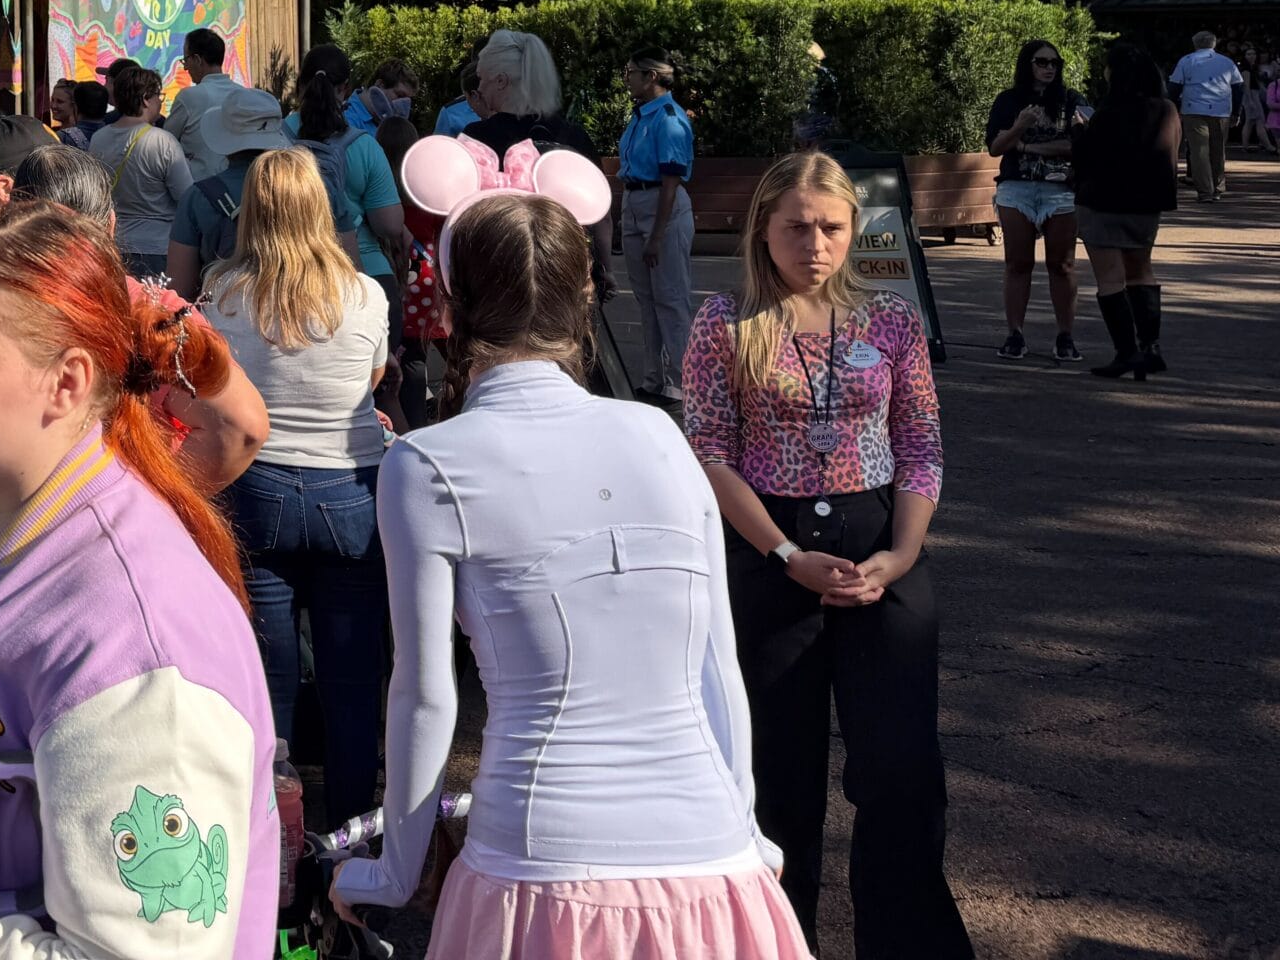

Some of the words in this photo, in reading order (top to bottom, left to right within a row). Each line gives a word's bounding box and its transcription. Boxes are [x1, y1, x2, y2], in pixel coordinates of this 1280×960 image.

[145, 28, 171, 49] DAY
[855, 233, 897, 249] VIEW
[857, 260, 907, 275] CK-IN
